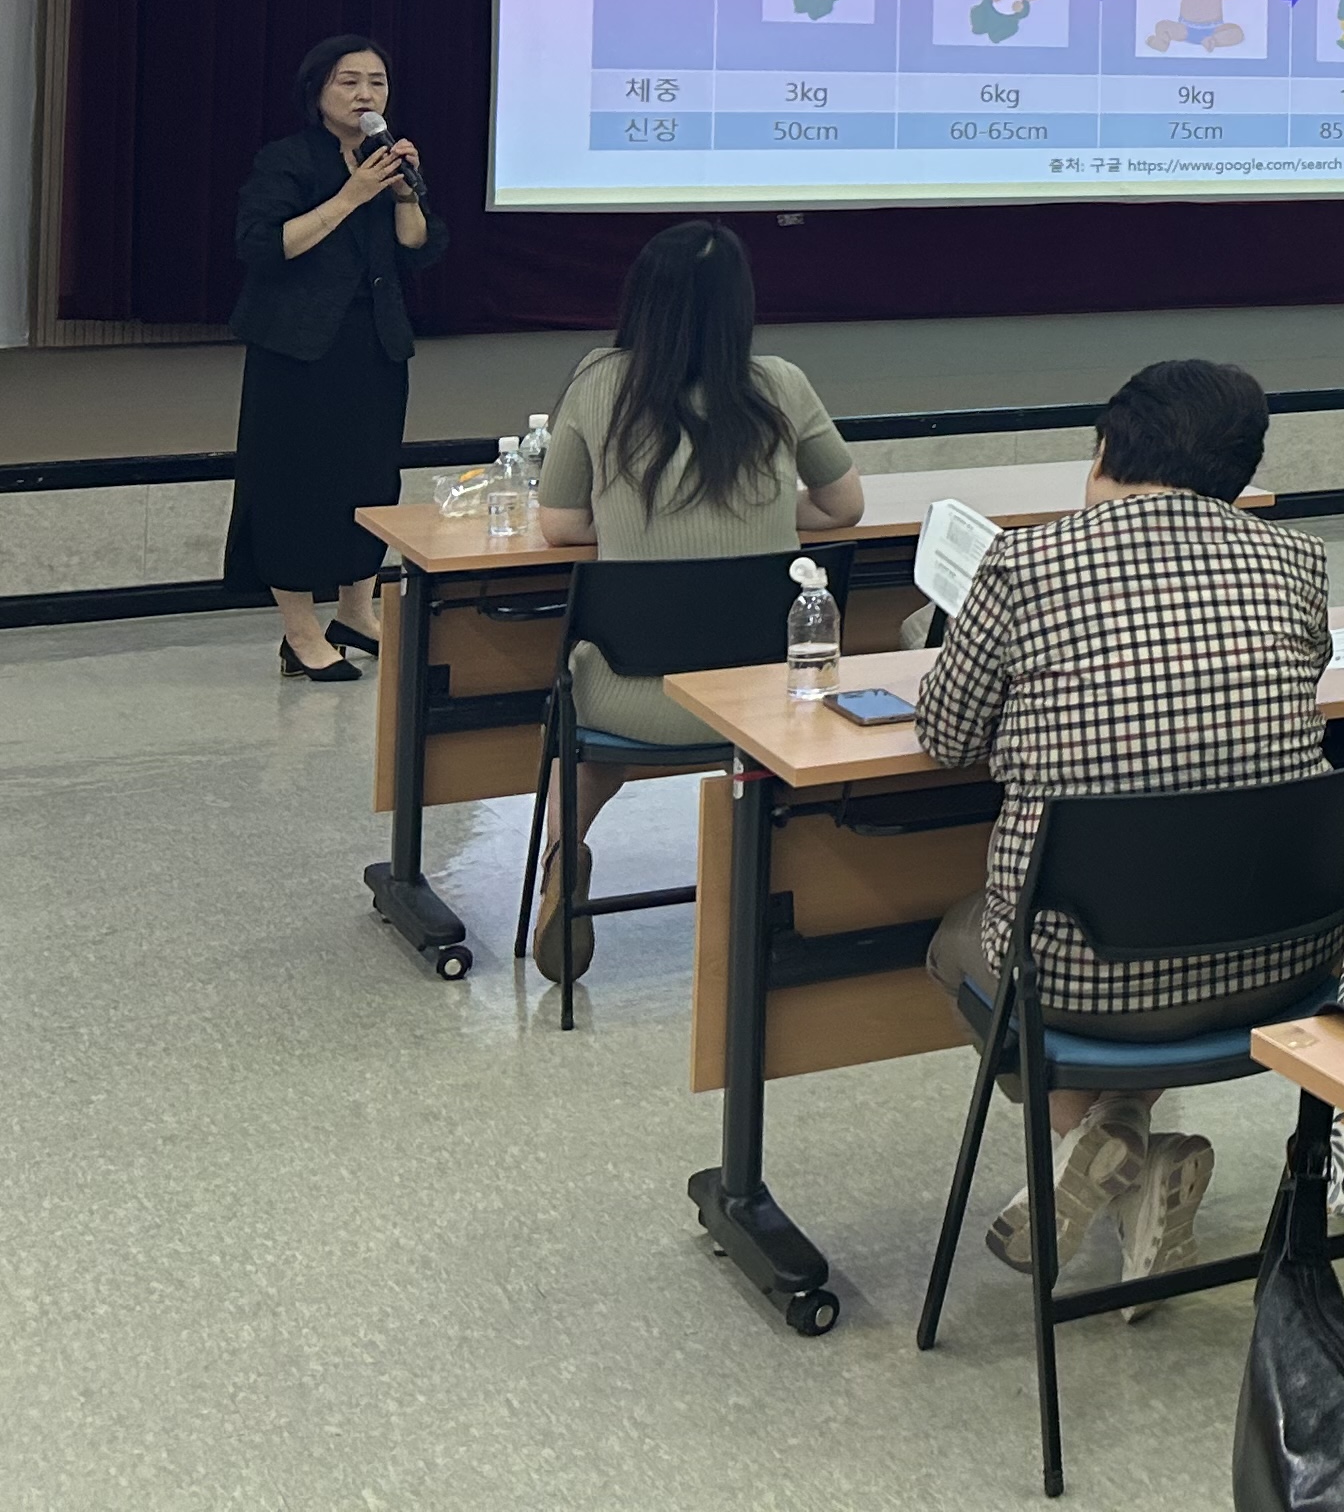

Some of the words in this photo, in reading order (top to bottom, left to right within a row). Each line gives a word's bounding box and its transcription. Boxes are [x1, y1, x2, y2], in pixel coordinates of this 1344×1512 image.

[624, 77, 682, 104] 체중
[785, 81, 829, 108] 3kg
[979, 83, 1021, 109] 6kg
[1177, 86, 1216, 110] 9kg
[623, 117, 679, 143] 신장
[773, 120, 840, 142] 50cm
[949, 121, 1049, 142] 60-65cm
[1168, 121, 1224, 141] 75cm
[1049, 157, 1085, 174] 출처:
[1089, 157, 1122, 173] 구글
[1127, 157, 1343, 175] https://www.google.com/search
